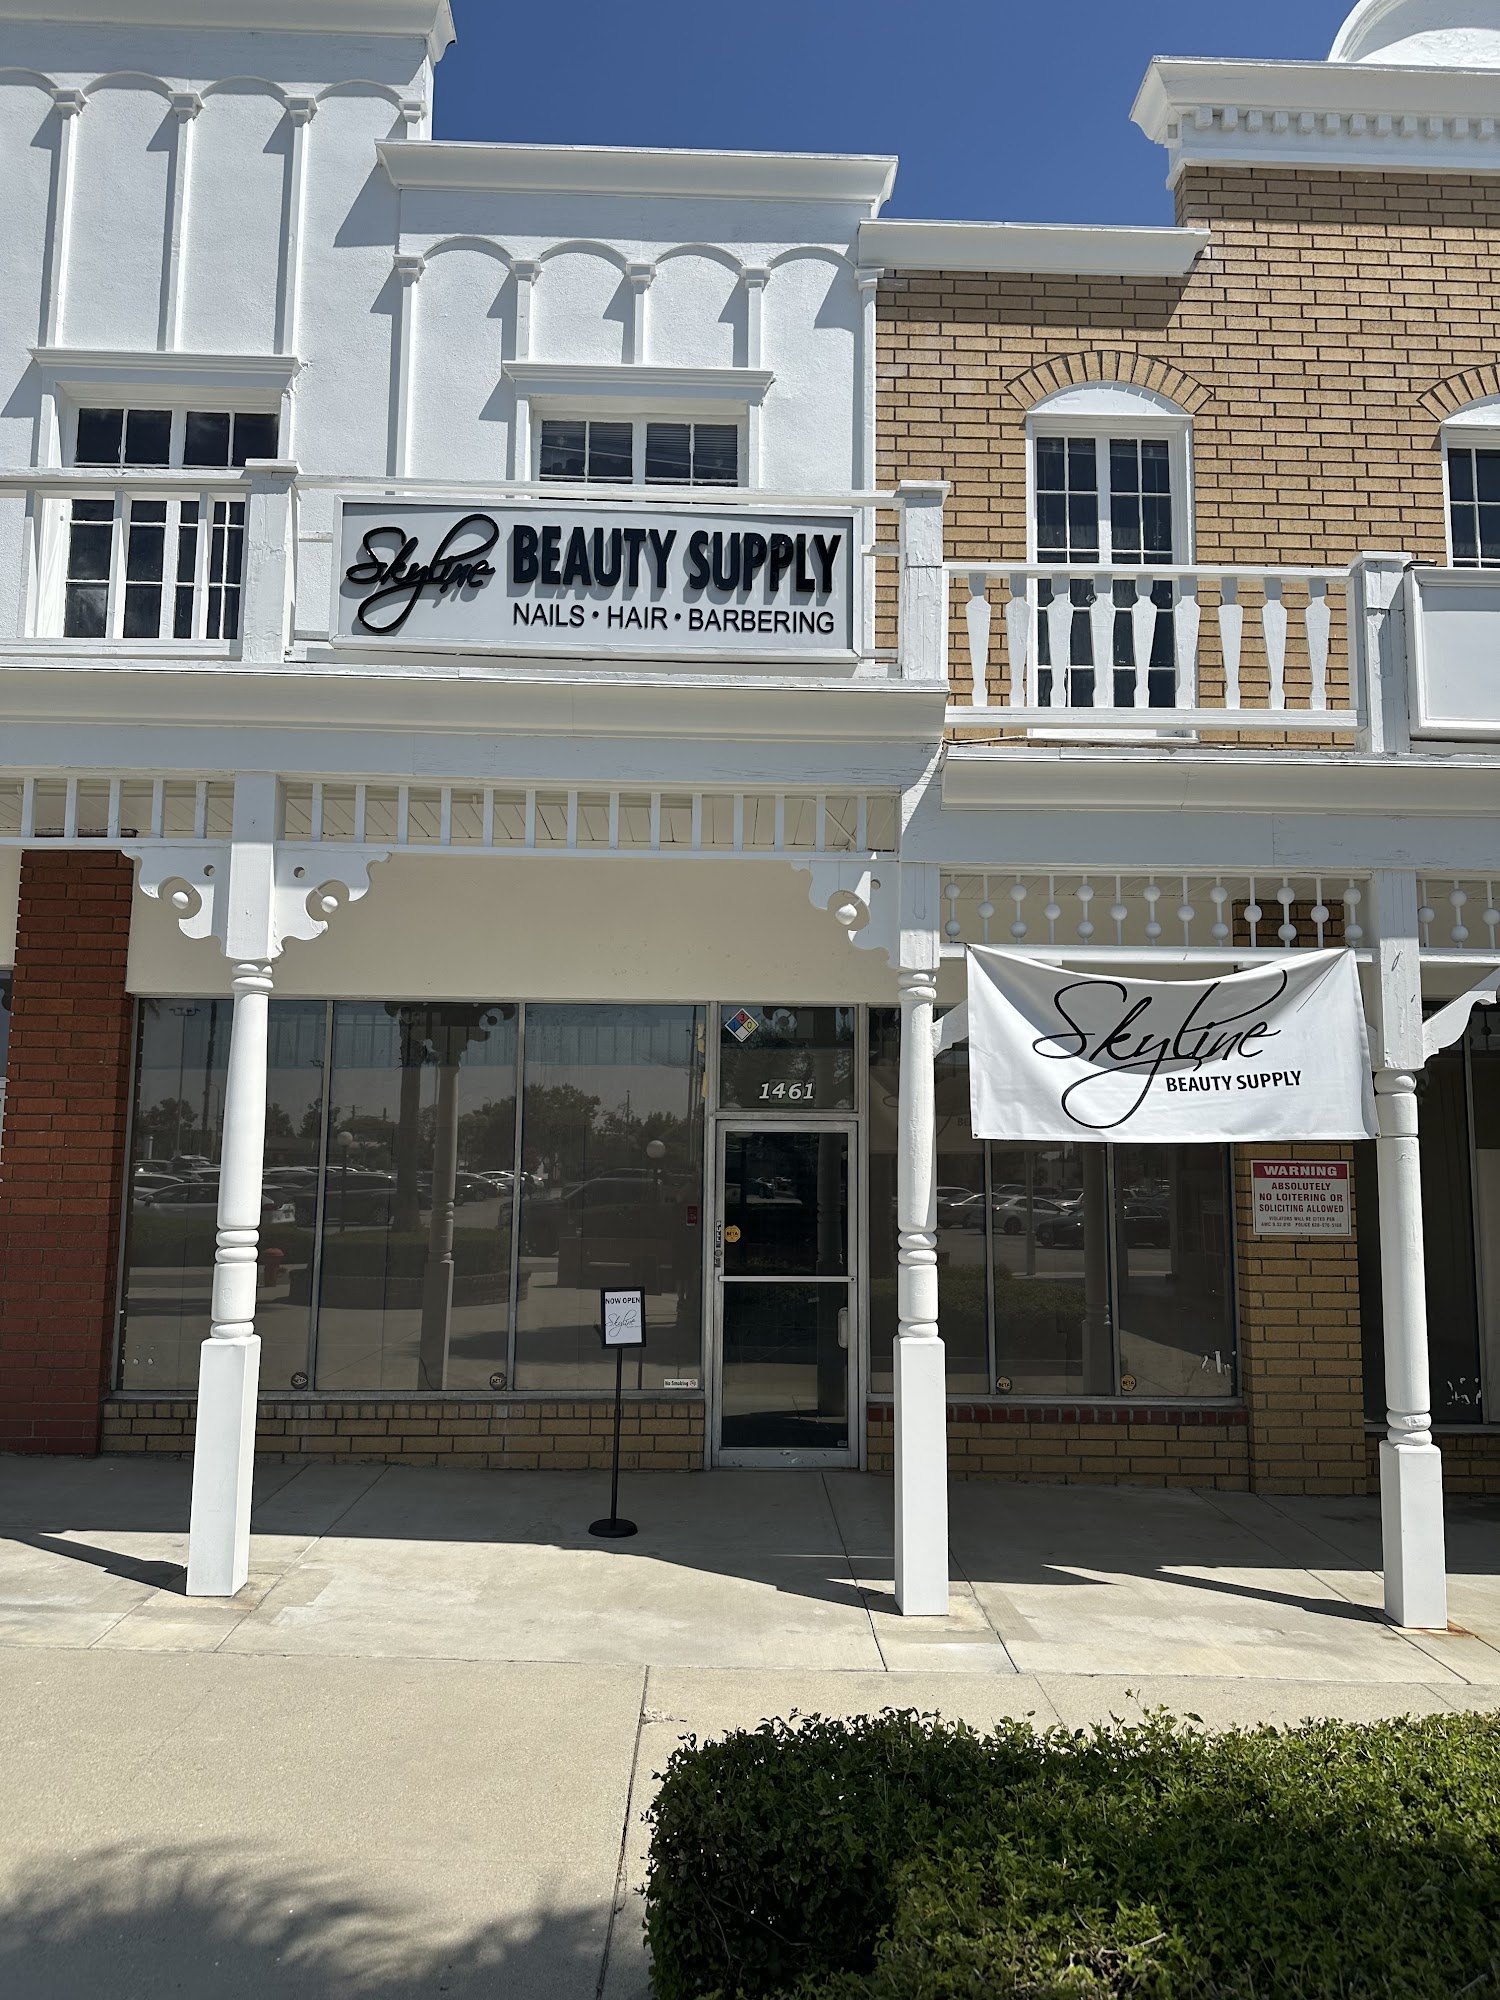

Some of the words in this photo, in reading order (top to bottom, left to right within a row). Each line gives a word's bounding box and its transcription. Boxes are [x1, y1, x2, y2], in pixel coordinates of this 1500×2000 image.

[345, 513, 500, 633] Skyline
[513, 525, 677, 588] BEAUTY
[689, 530, 841, 593] SUPPLY
[513, 602, 585, 627] NAILS
[607, 606, 668, 631] HAIR
[688, 608, 835, 634] BARBERING
[739, 1013, 745, 1022] 3
[1032, 969, 1288, 1129] Skyline
[1165, 1075, 1232, 1092] BEAUTY
[1236, 1070, 1302, 1090] SUPPLY
[758, 1082, 815, 1100] 1461
[1263, 1165, 1338, 1177] WARNING
[1271, 1182, 1331, 1191] ABSOLUTELY
[1259, 1193, 1272, 1201] NO
[1276, 1193, 1326, 1202] LOITERING
[1330, 1194, 1343, 1202] OR
[1259, 1204, 1304, 1213] SOLICITING
[1306, 1204, 1344, 1213] ALLOWED
